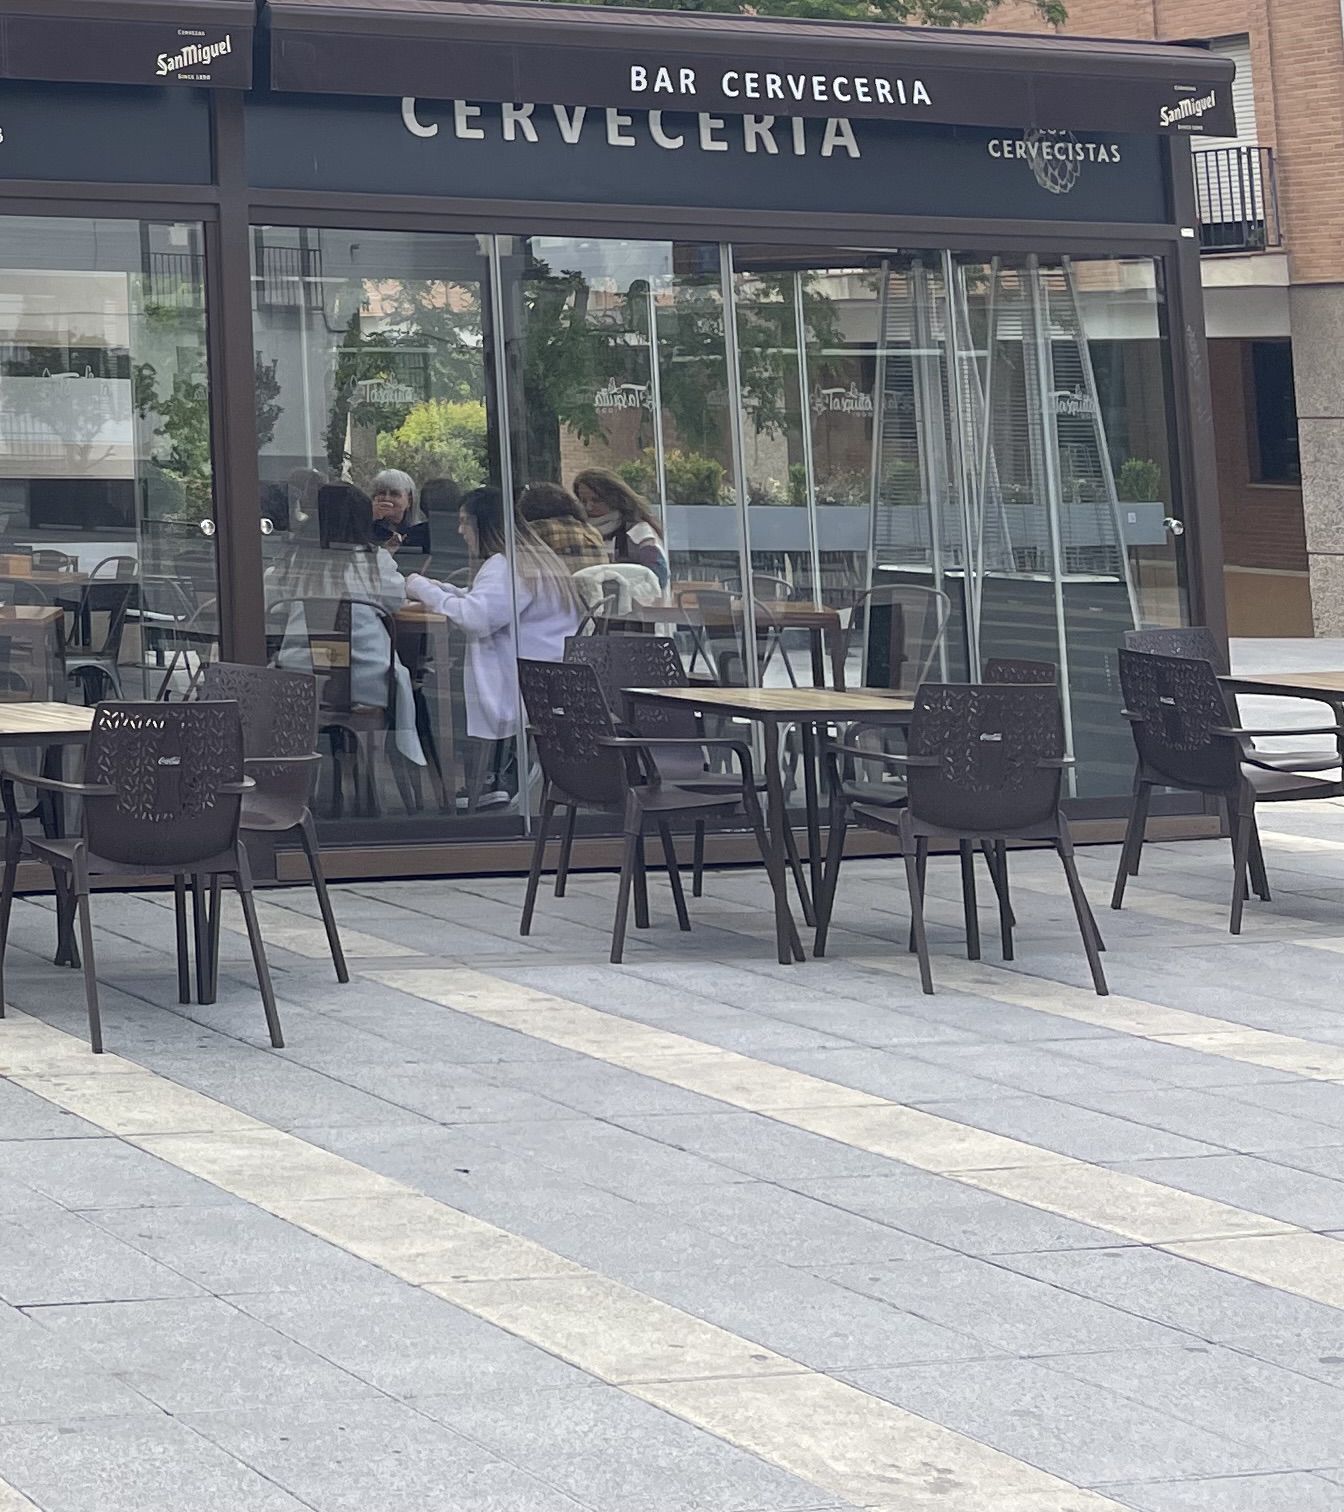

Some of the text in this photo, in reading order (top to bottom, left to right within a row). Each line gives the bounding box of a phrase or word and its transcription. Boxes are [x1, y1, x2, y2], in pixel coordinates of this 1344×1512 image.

[630, 65, 934, 106] BAR CERVECERIA
[401, 96, 862, 159] CERVECERIA
[988, 139, 1122, 163] CERVECISTAS
